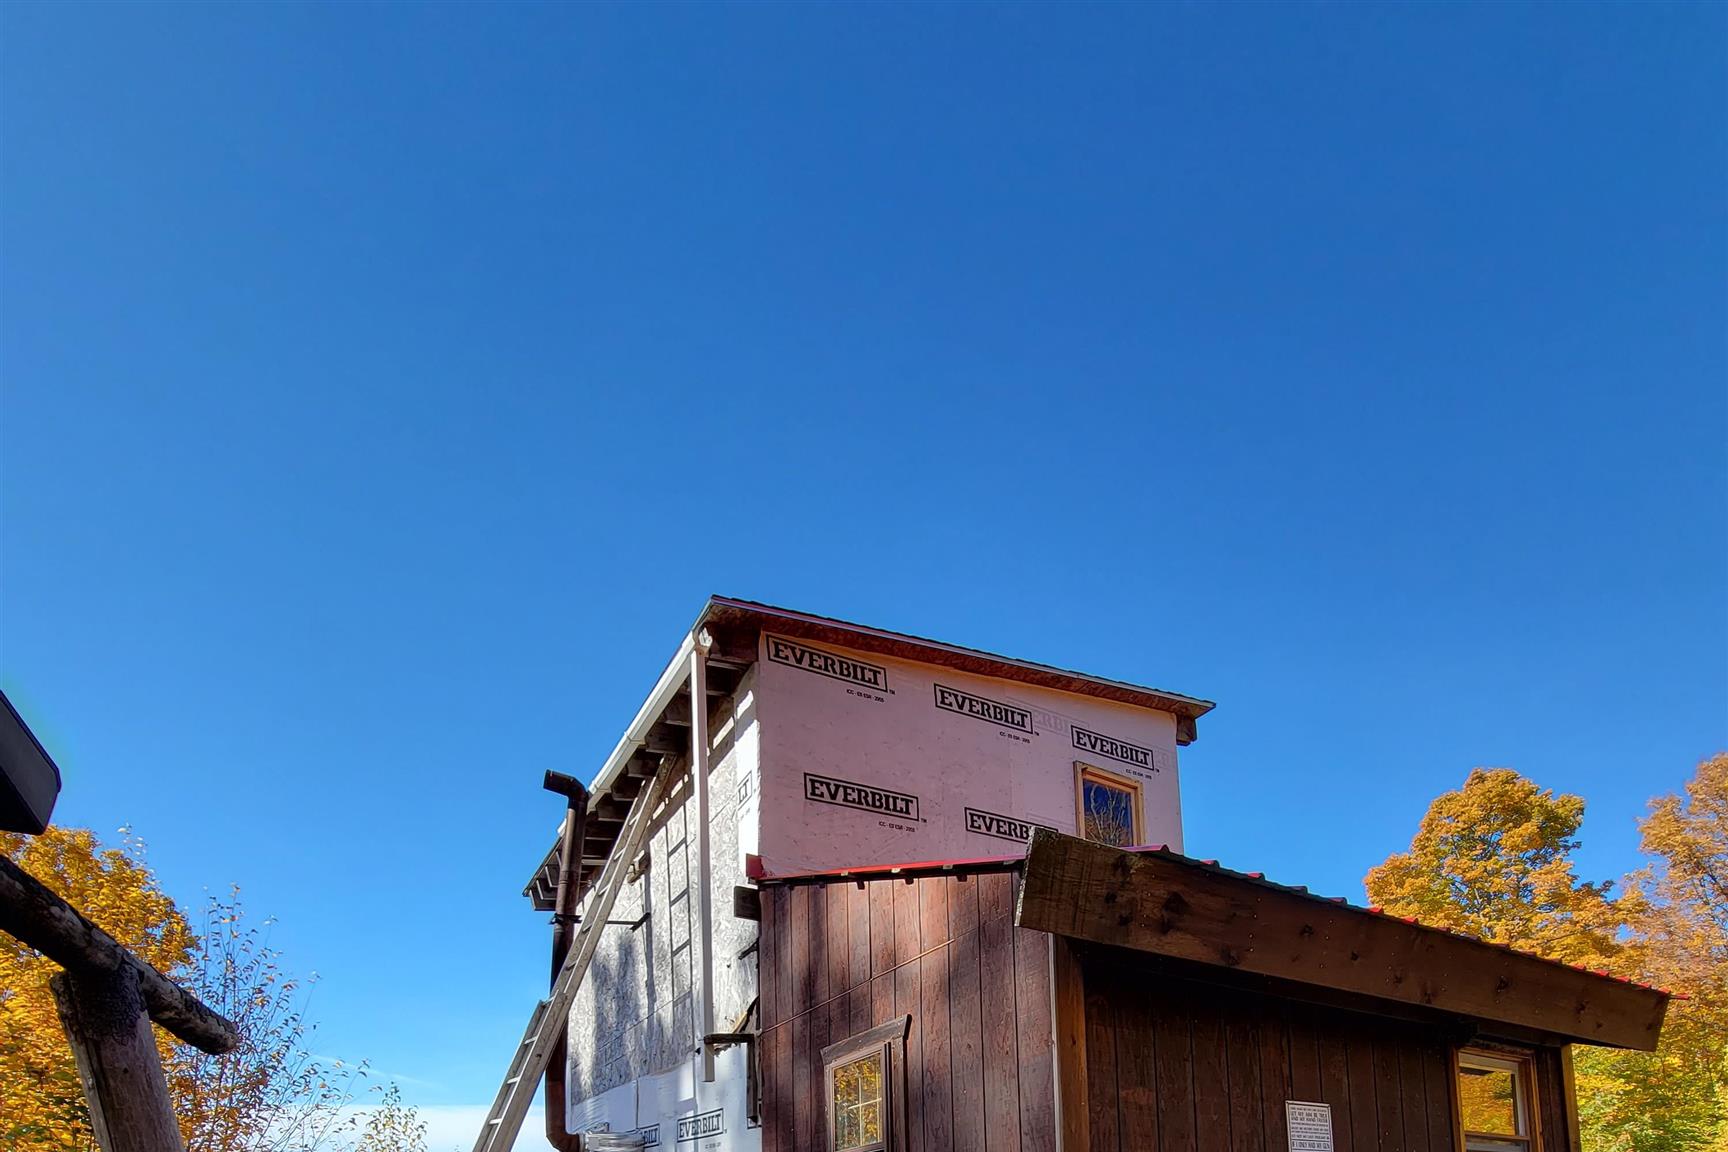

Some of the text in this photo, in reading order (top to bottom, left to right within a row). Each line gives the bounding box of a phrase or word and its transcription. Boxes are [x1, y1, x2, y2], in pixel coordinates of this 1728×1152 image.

[772, 640, 881, 686] EVERBILT
[938, 688, 1028, 728] EVERBILT
[1075, 730, 1150, 766] EVERBILT
[808, 778, 914, 815] EVERBILT
[968, 812, 1030, 840] EVERB
[679, 1113, 721, 1138] EVERBILT
